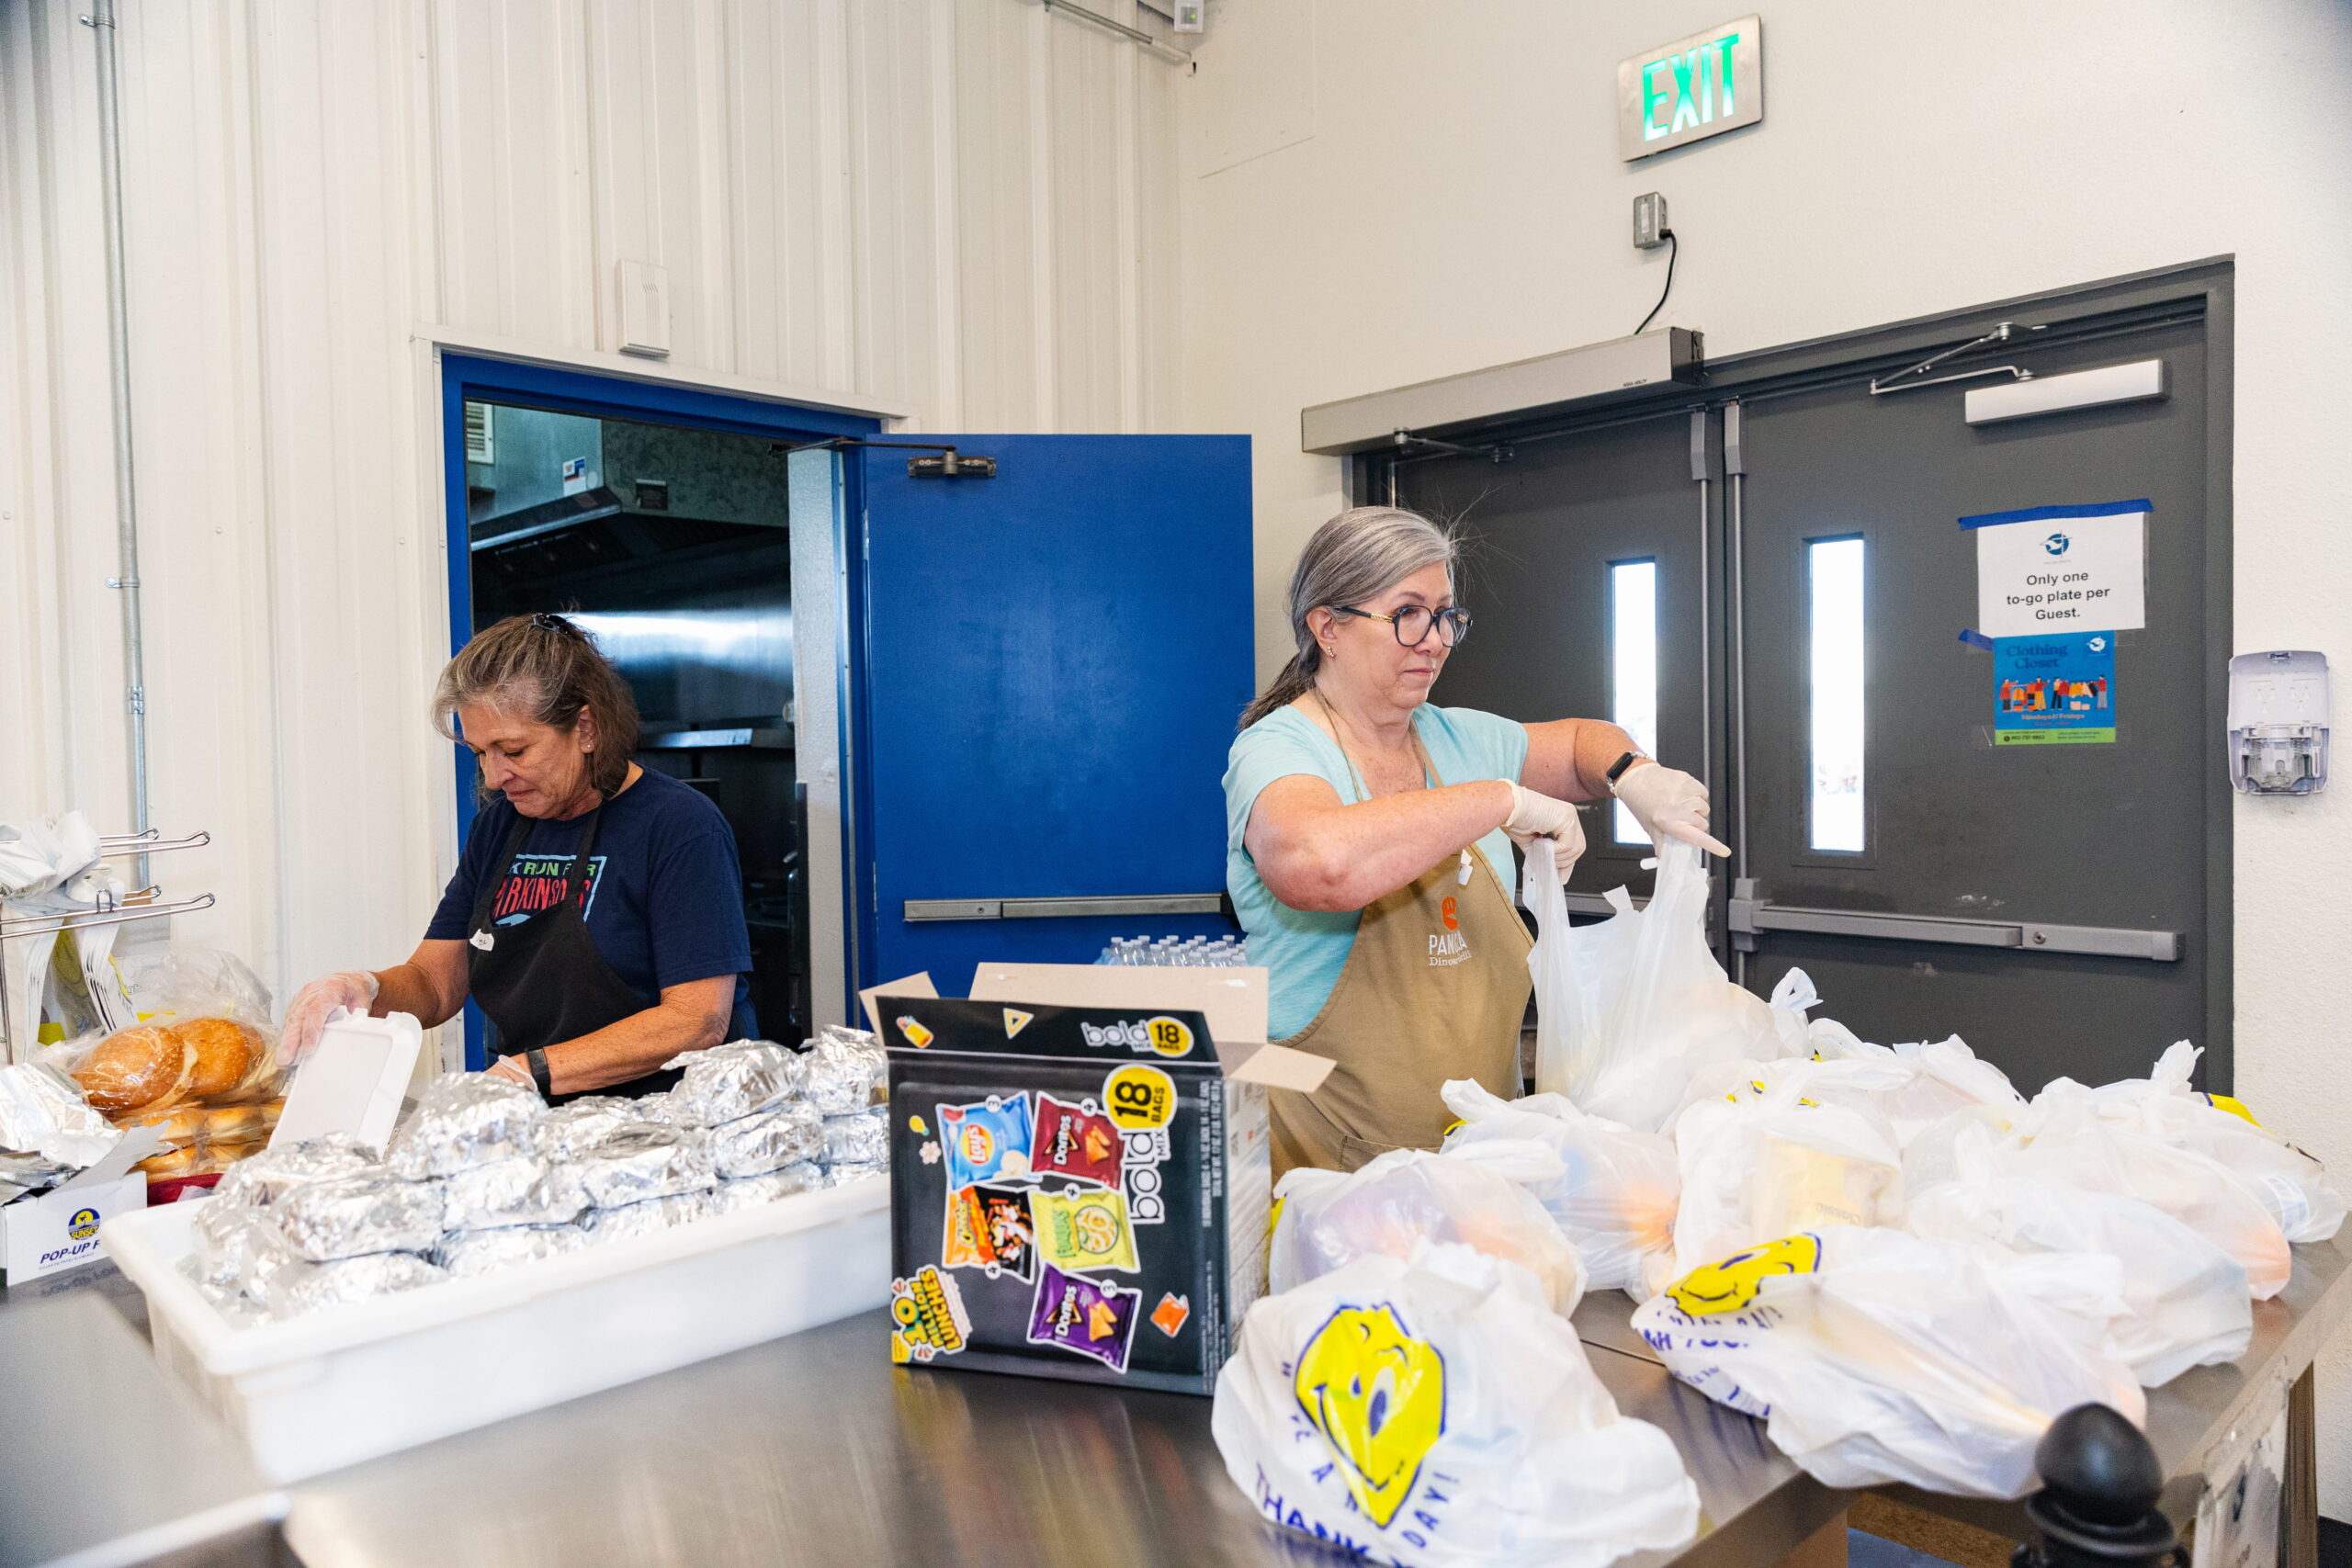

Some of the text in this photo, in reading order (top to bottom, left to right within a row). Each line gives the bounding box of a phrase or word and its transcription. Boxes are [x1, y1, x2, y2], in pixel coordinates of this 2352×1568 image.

[1642, 33, 1739, 142] EXIT
[2026, 571, 2089, 589] Only one
[2007, 588, 2110, 606] to-go plate per
[2035, 607, 2080, 620] Guest.
[2007, 643, 2067, 658] Clothing
[2015, 658, 2059, 670] Closet
[523, 862, 559, 876] RUN
[562, 863, 596, 876] FR
[1082, 1021, 1180, 1044] bold 18
[990, 1099, 999, 1107] 3
[1114, 1081, 1152, 1118] 18
[1151, 1086, 1165, 1122] BAGS
[1053, 1114, 1072, 1166] Doritos
[1155, 1131, 1166, 1156] MIX
[1121, 1132, 1160, 1220] bold
[71, 1225, 99, 1241] SUNSET
[40, 1242, 91, 1264] POP-UP
[894, 1296, 928, 1346] 10
[910, 1280, 944, 1348] MILLION
[920, 1269, 962, 1350] LUNCHES
[1056, 1284, 1078, 1337] Doritos
[1401, 1472, 1460, 1549] DAY!
